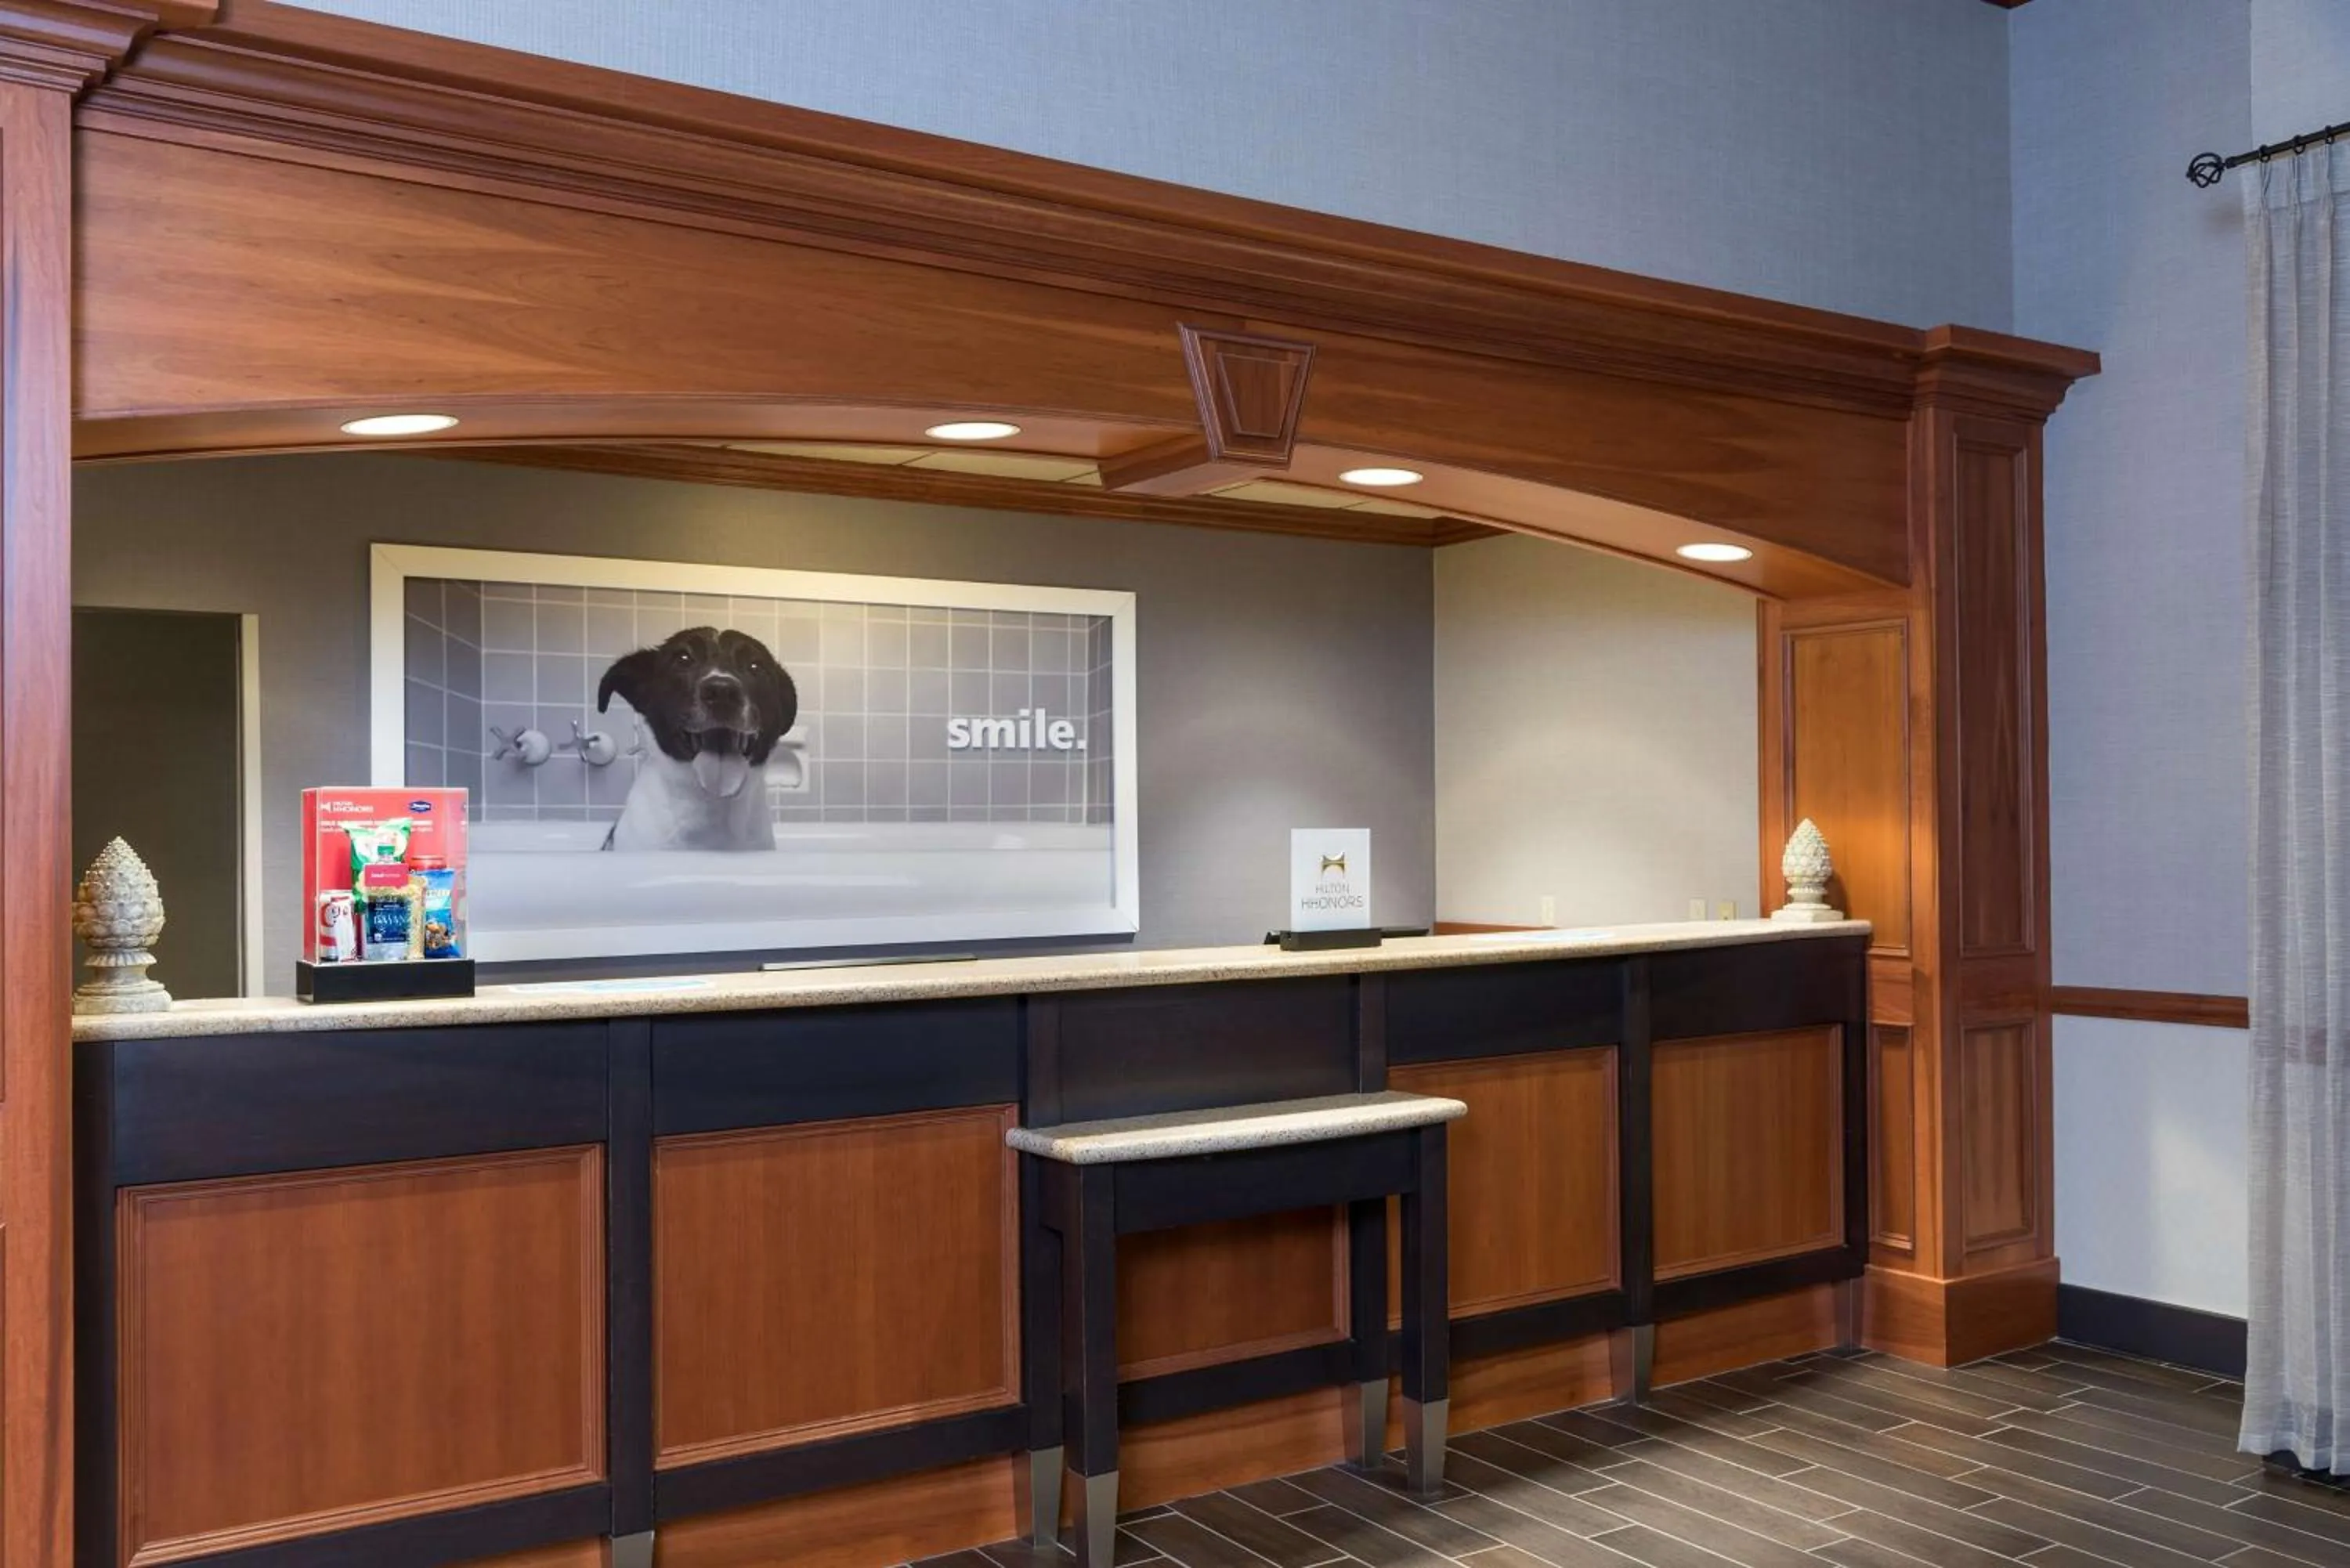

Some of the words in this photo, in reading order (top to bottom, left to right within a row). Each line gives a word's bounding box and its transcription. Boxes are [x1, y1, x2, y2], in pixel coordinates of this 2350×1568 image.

[947, 707, 1087, 750] smile.
[1315, 882, 1350, 894] HILTON
[1301, 894, 1365, 910] HHONORS
